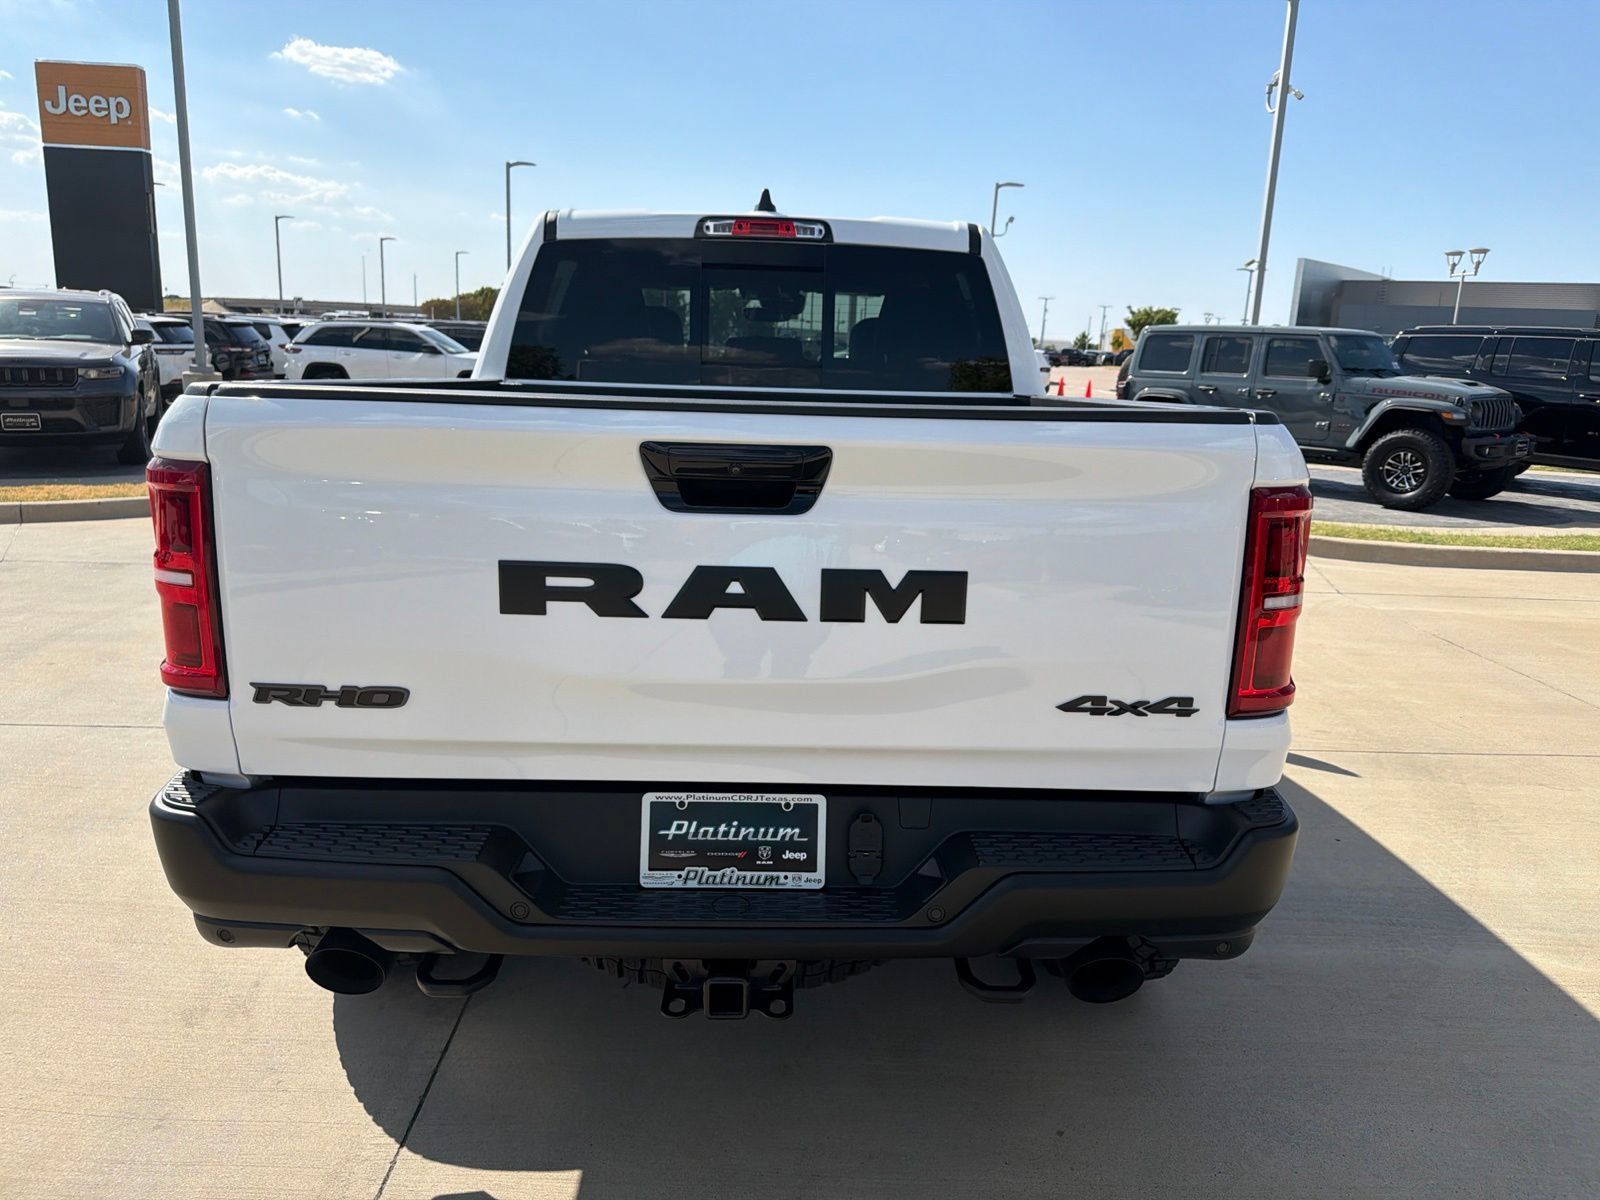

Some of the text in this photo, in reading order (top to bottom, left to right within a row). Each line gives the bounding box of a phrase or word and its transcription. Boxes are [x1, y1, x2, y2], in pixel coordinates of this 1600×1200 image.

[44, 85, 131, 125] Jeep
[1371, 387, 1449, 401] RUBICON
[498, 560, 968, 625] RAM
[249, 682, 410, 709] RHO
[1055, 695, 1200, 717] 4x4
[658, 820, 809, 842] Platinum
[782, 850, 807, 861] Jeep
[682, 869, 789, 886] Platinum
